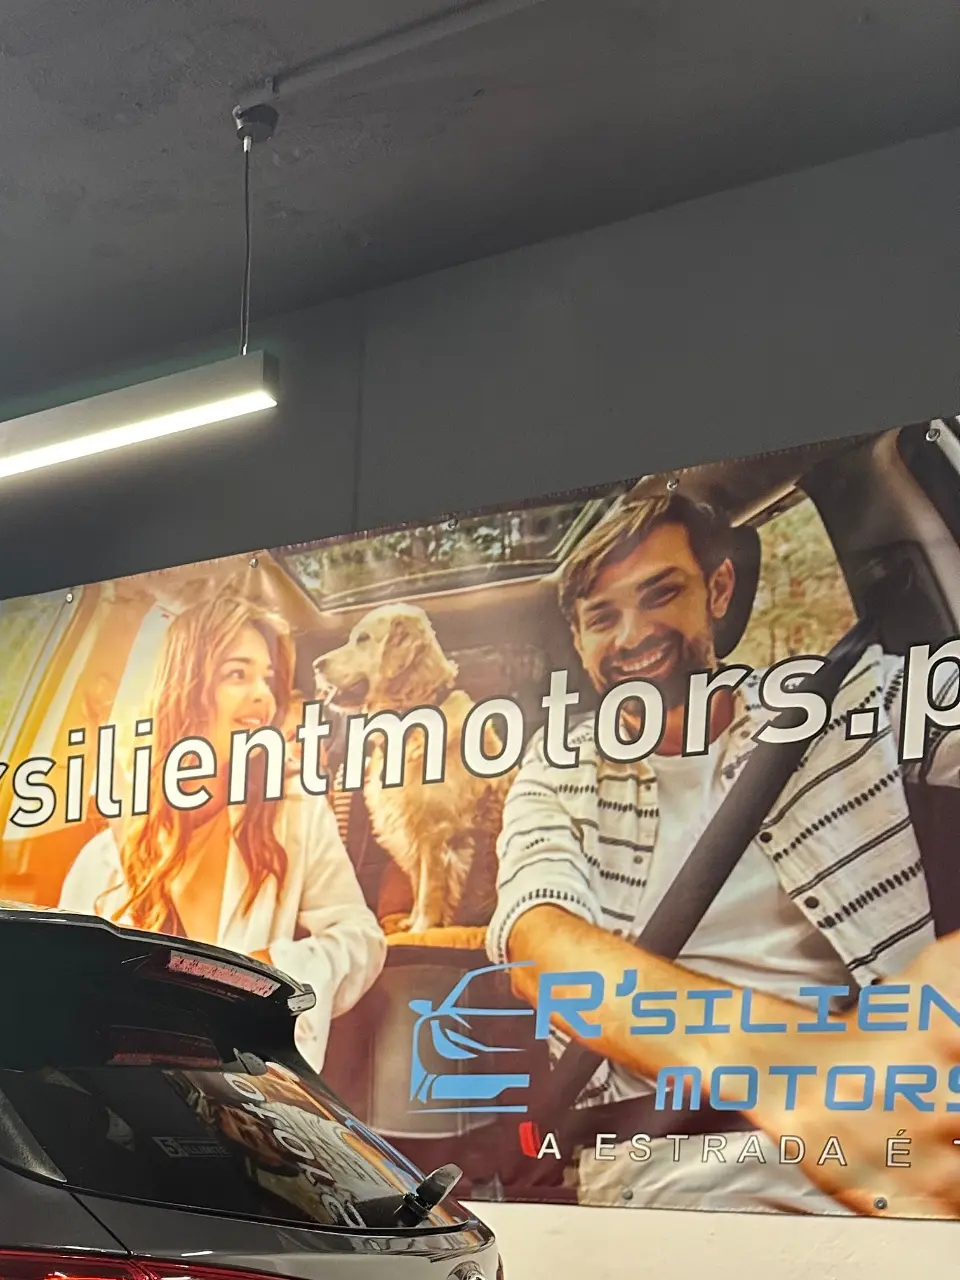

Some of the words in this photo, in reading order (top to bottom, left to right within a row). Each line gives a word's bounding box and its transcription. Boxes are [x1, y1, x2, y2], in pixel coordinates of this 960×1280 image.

[654, 1064, 960, 1113] MOTOR
[536, 1132, 562, 1160] A
[594, 1132, 848, 1167] ESTRADA
[885, 1128, 912, 1168] É
